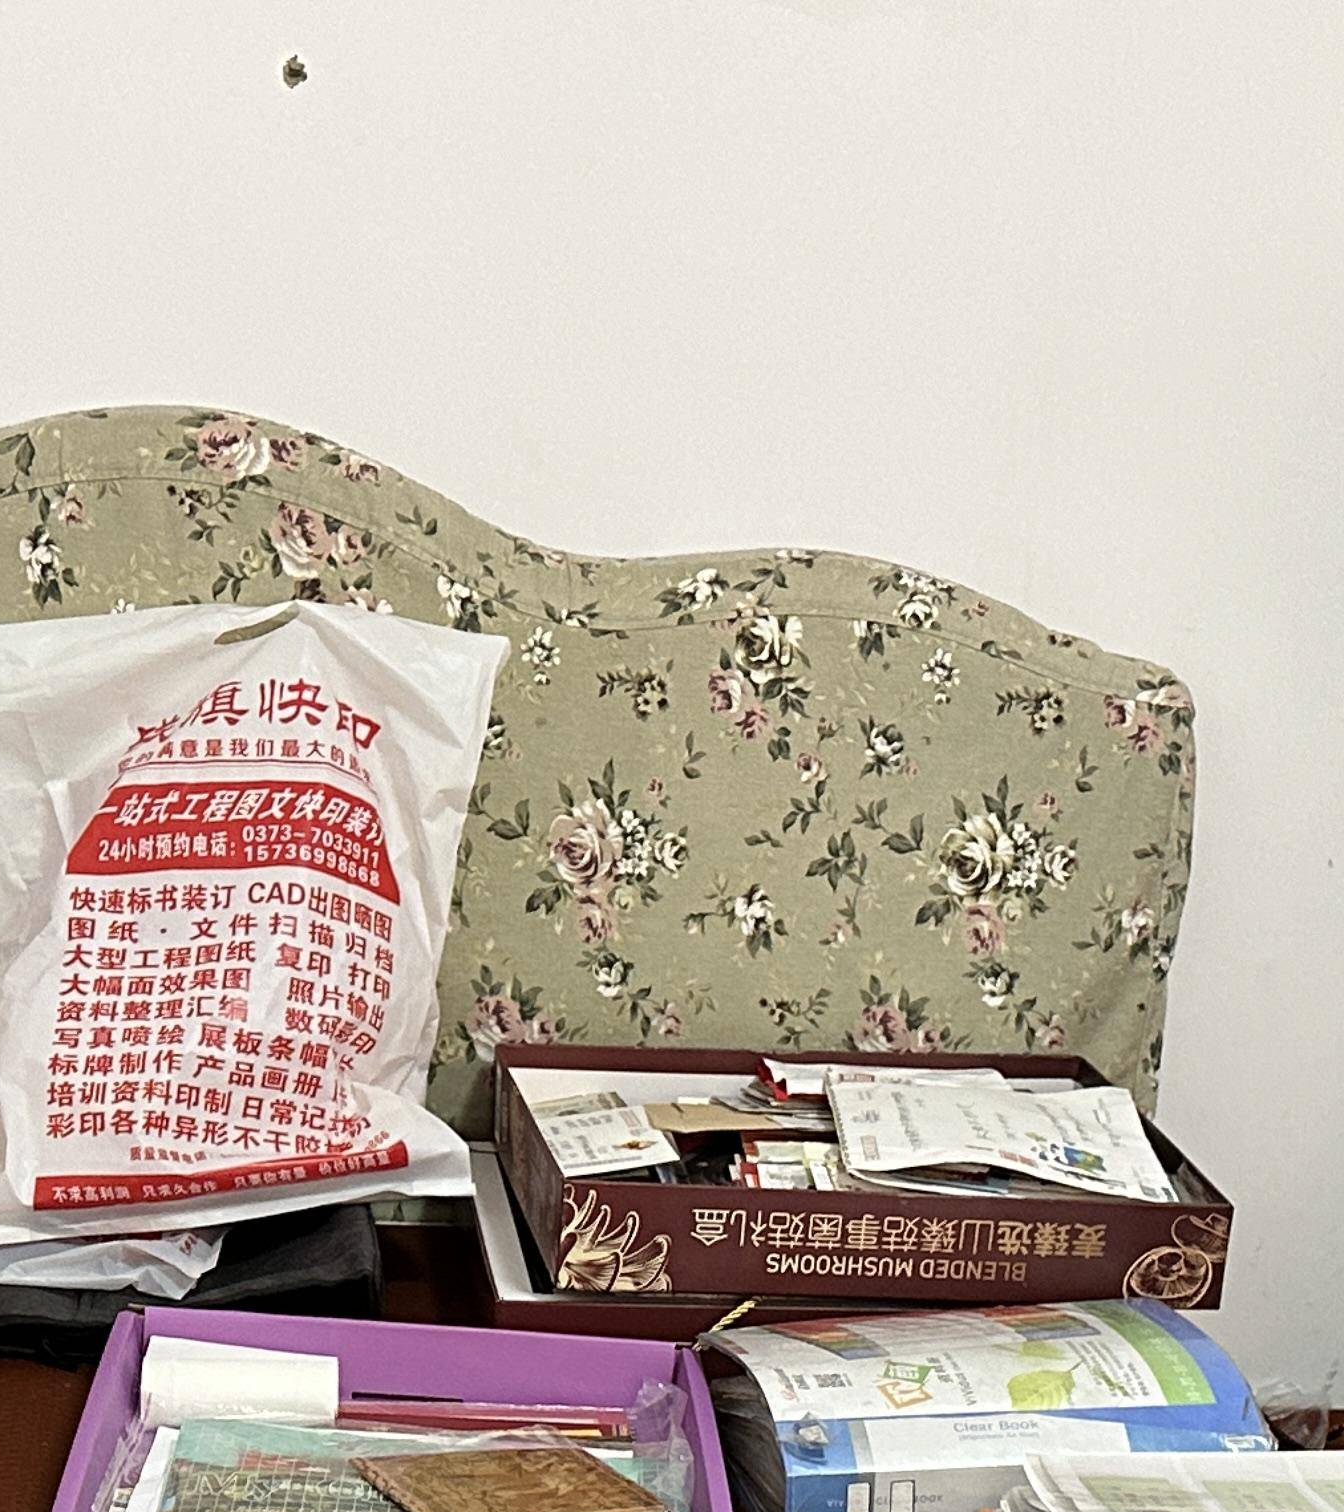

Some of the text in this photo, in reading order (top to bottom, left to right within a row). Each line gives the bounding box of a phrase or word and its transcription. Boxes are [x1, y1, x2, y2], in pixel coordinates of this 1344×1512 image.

[69, 882, 392, 943] 快速标书装订 CAD出图晒图
[62, 940, 256, 970] 大型工程图纸
[56, 995, 249, 1023] 资料整理汇编
[59, 968, 384, 1033] 大幅面效果图 照片输出
[52, 1023, 185, 1049] 写真喷绘
[47, 1050, 184, 1077] 标牌制作
[193, 1054, 323, 1098] 产品画册
[46, 1079, 233, 1117] 培训资料印制
[764, 1253, 1026, 1281] BLENDED MUSHROOMS
